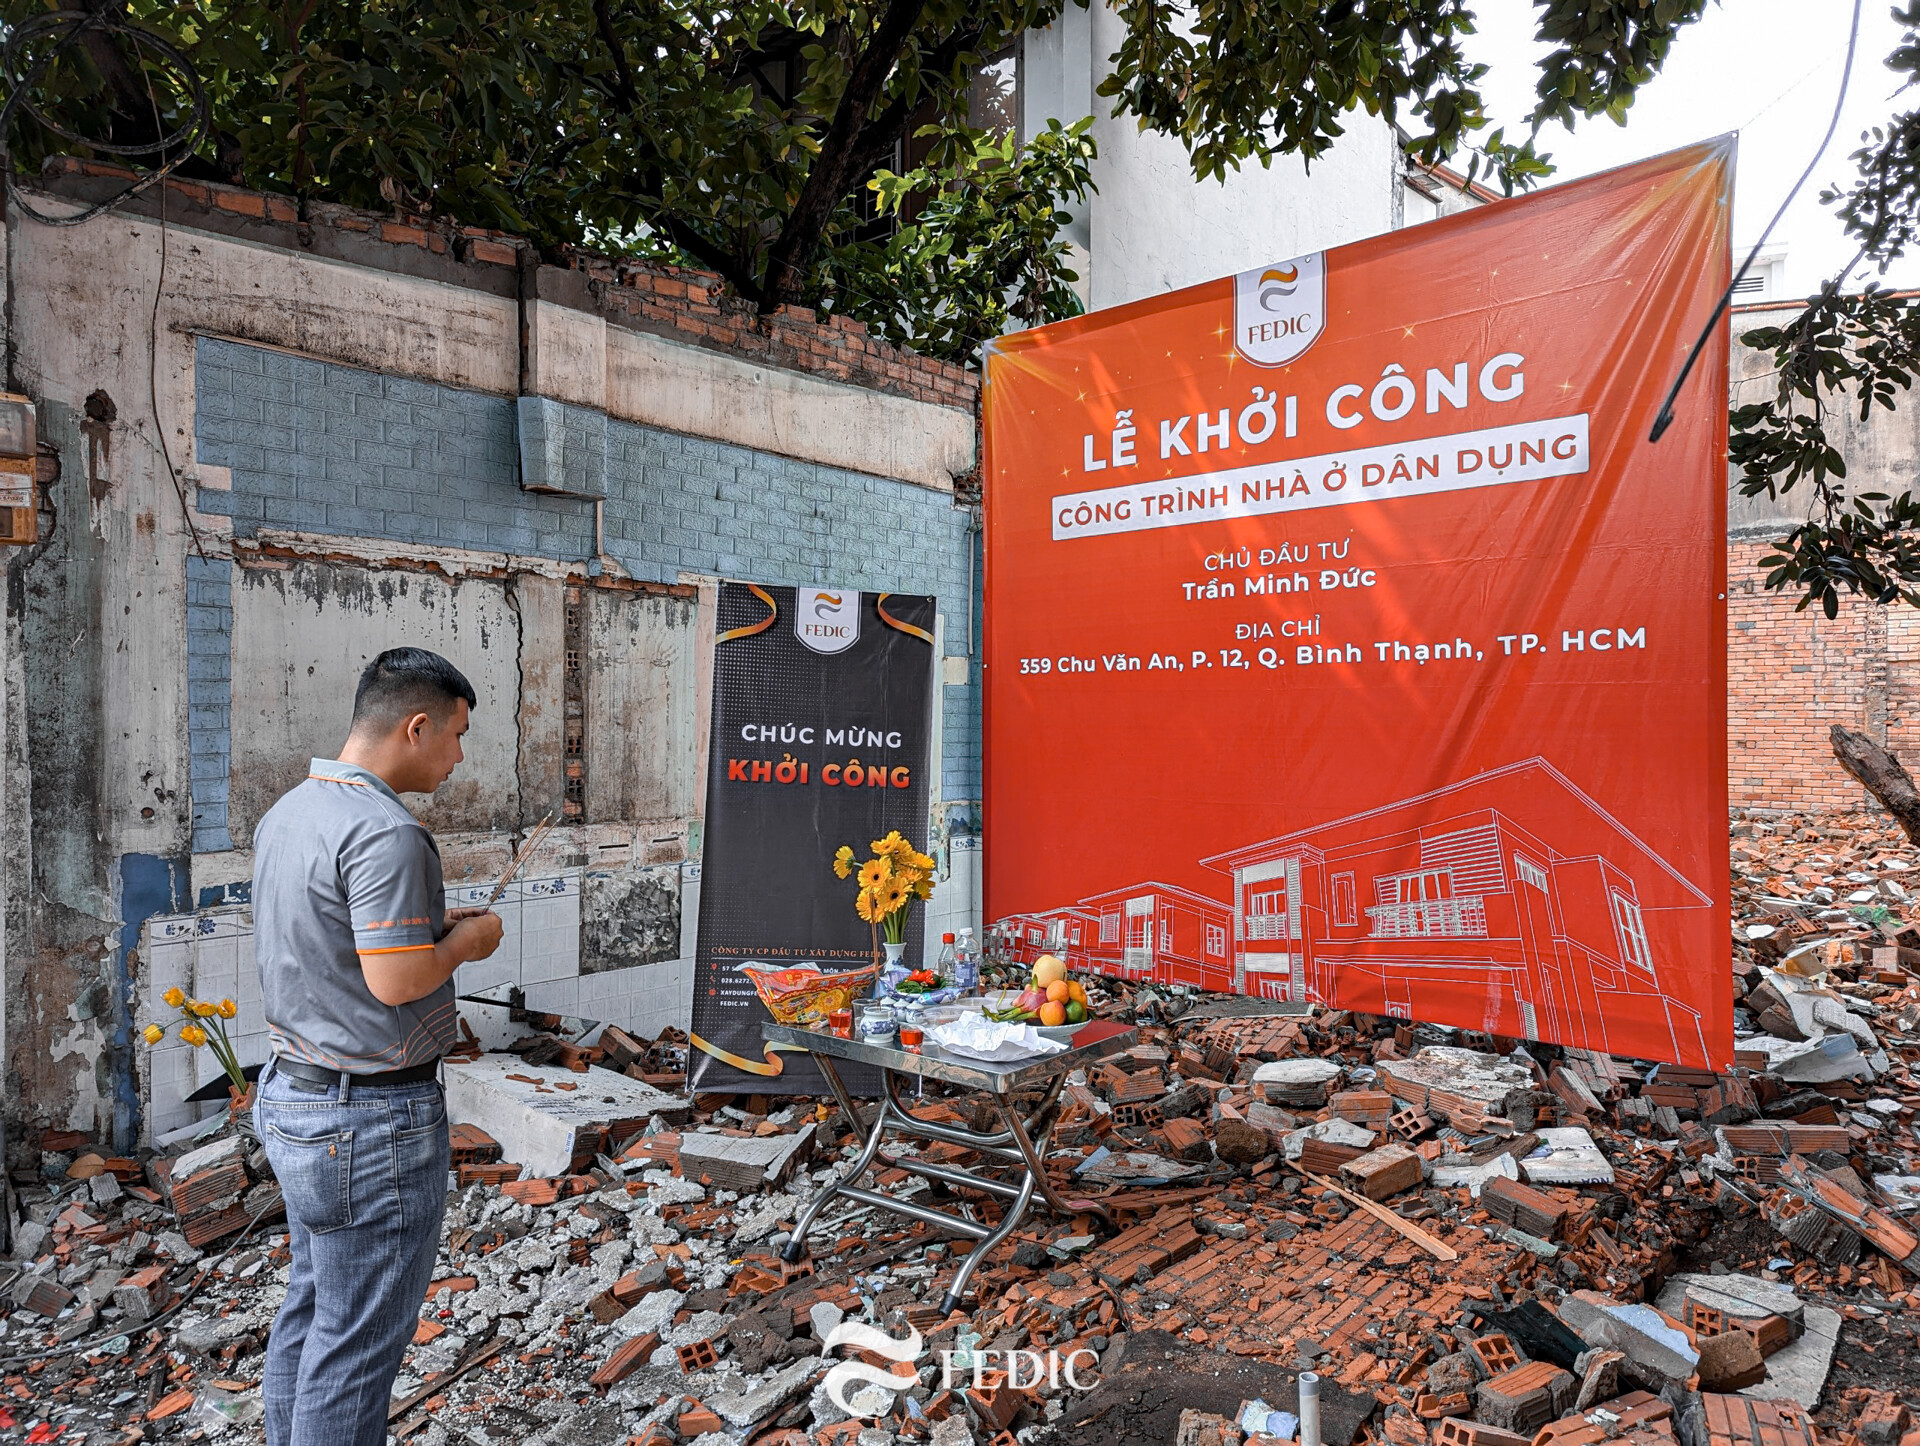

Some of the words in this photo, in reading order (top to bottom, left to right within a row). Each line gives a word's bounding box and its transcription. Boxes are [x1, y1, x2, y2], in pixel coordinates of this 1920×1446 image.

[1248, 313, 1312, 345] FEDIC
[1083, 408, 1138, 473] LỄ
[1159, 385, 1298, 460] KHỞI
[1325, 352, 1525, 430] CÔNG
[1058, 500, 1131, 528] CÔNG
[1141, 486, 1228, 517] TRÌNH
[1241, 468, 1311, 504] NHÀ
[1322, 460, 1347, 492] Ở
[1361, 453, 1439, 487] DÂN
[1457, 434, 1577, 476] DỤNG
[1204, 546, 1251, 571] CHỦ
[1258, 541, 1310, 567] ĐẦU
[1317, 537, 1350, 560] TƯ
[1182, 577, 1236, 601] Trần
[1244, 572, 1309, 596] Minh
[1319, 566, 1376, 590] Đức
[805, 624, 851, 639] FEDIC
[1235, 622, 1275, 643] ĐỊA
[1281, 614, 1321, 638] CHỈ
[1019, 658, 1052, 675] 359
[1057, 656, 1096, 673] Chu
[1102, 652, 1141, 672] Văn
[1147, 653, 1184, 672] An,
[1192, 651, 1213, 668] P.
[1220, 649, 1250, 670] 12,
[1258, 647, 1286, 670] Q.
[1296, 642, 1362, 665] Bình
[1374, 638, 1484, 665] Thạnh,
[1497, 634, 1547, 656] TP.
[1562, 627, 1646, 651] HCM
[741, 723, 815, 745] CHÚC
[825, 725, 902, 748] MỪNG
[728, 753, 809, 784] KHỞI
[821, 758, 911, 789] CÔNG
[711, 946, 739, 954] CÔNG
[742, 947, 754, 955] TY
[757, 947, 769, 955] CP
